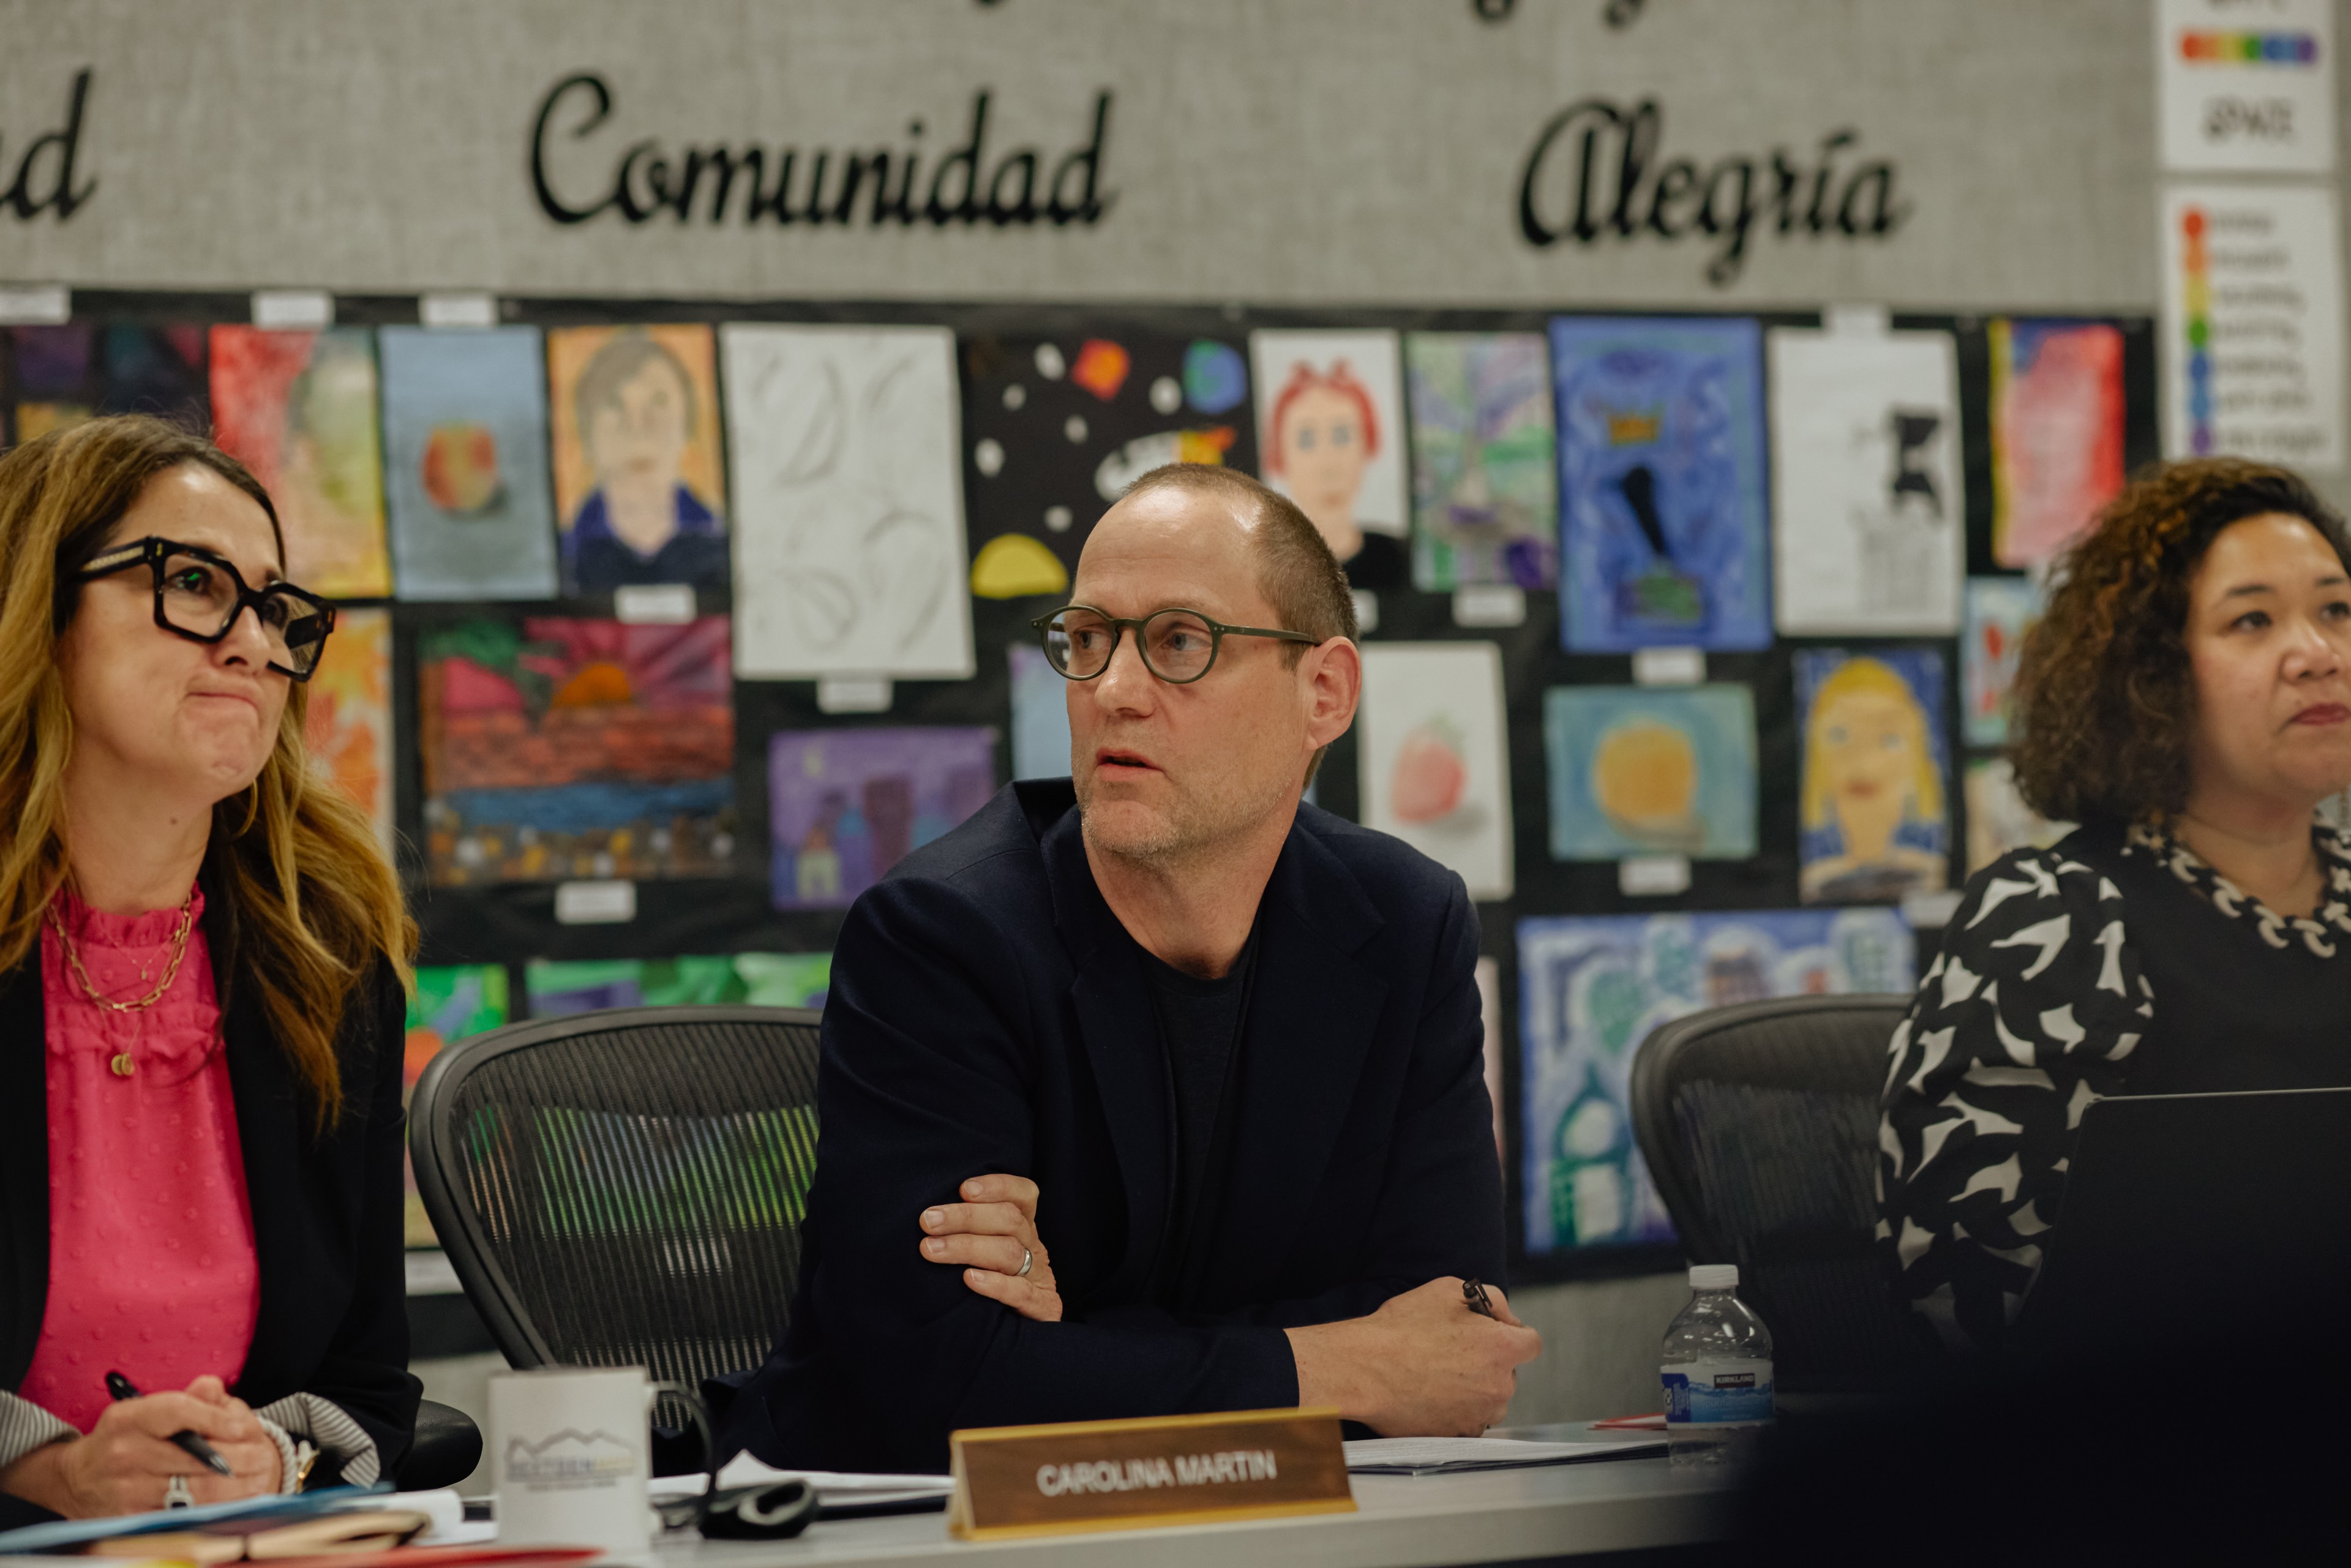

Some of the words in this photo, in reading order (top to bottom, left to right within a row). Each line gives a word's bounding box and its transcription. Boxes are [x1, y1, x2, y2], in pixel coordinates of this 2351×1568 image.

[529, 71, 1117, 228] Comunidad
[1517, 92, 1914, 288] Alegría
[1715, 1375, 1754, 1384] KIRKLAND
[1037, 1457, 1174, 1496] CAROLINA
[1176, 1449, 1277, 1485] MARTIN
